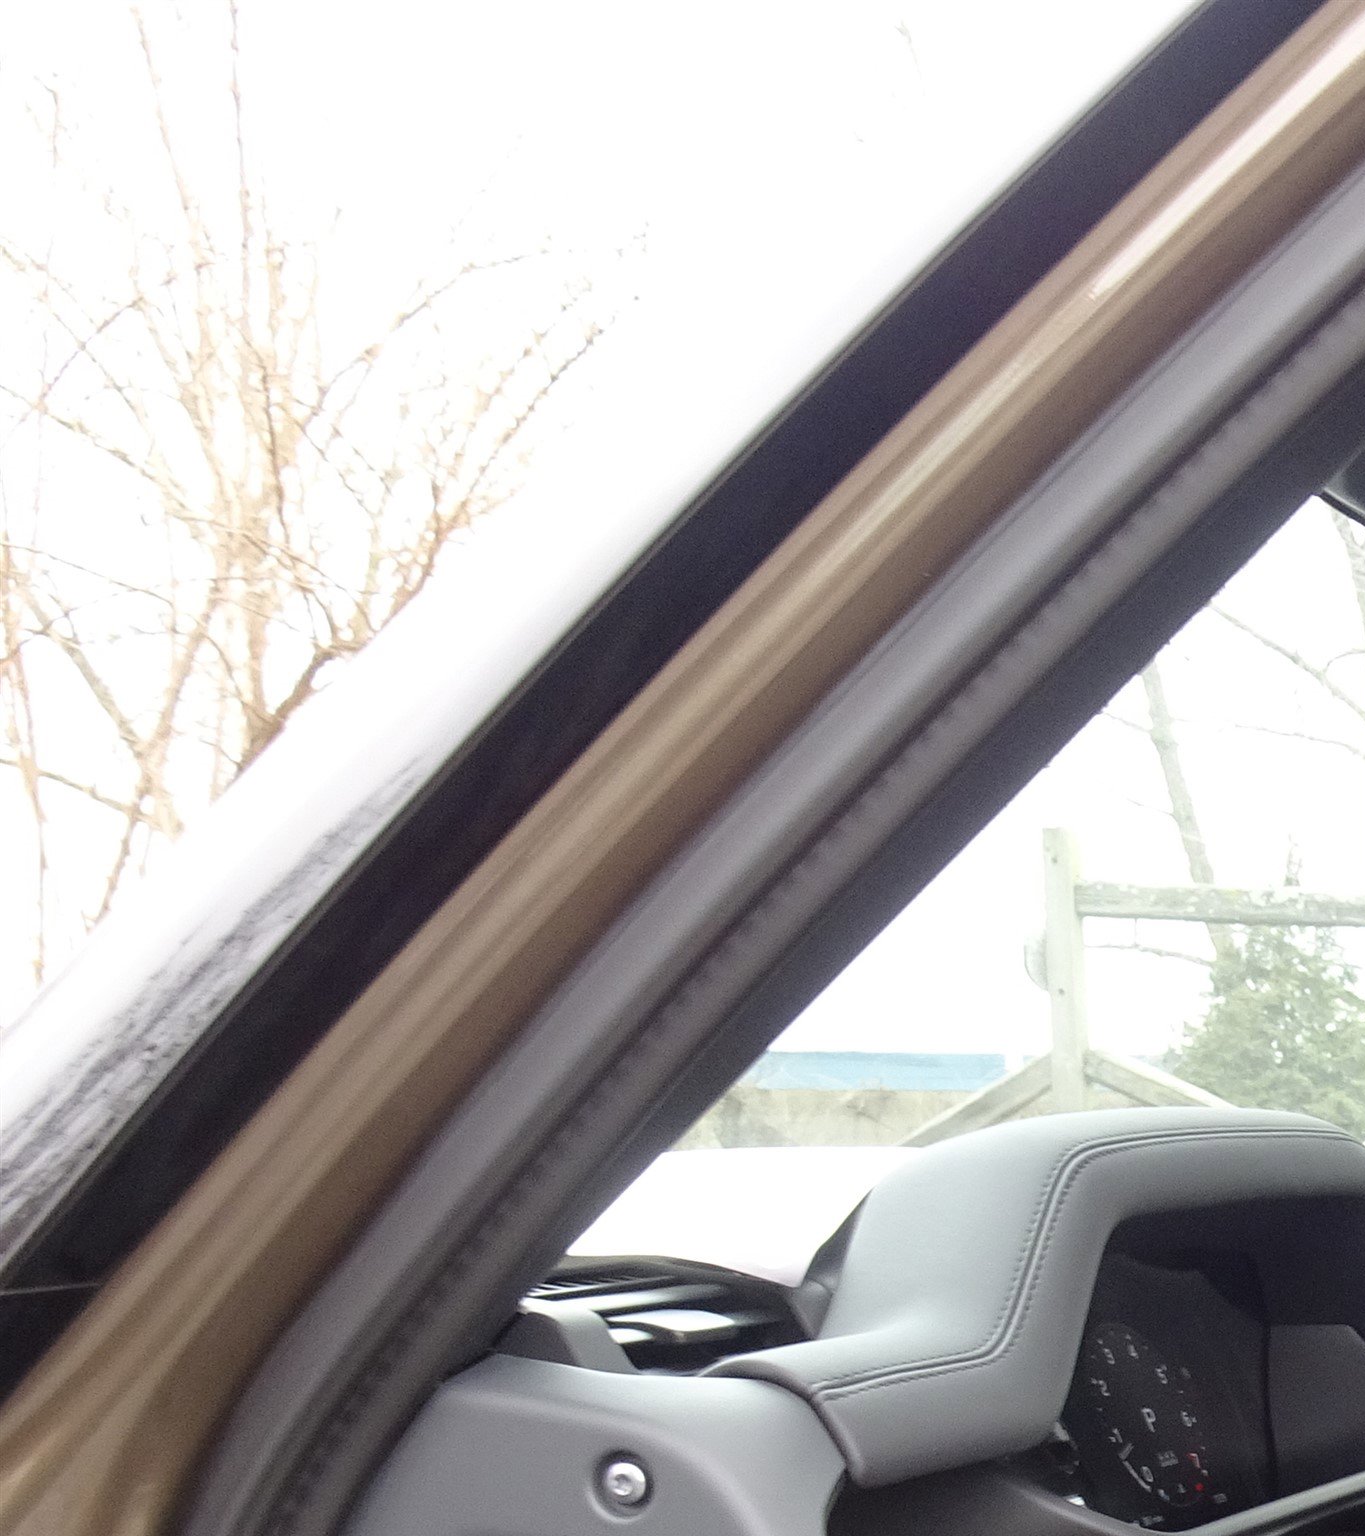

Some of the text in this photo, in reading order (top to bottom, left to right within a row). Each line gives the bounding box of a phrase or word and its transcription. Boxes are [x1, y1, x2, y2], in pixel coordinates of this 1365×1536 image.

[1154, 1364, 1168, 1384] 5
[1098, 1379, 1111, 1396] 2
[1141, 1407, 1157, 1432] P
[1140, 1465, 1154, 1483] 0
